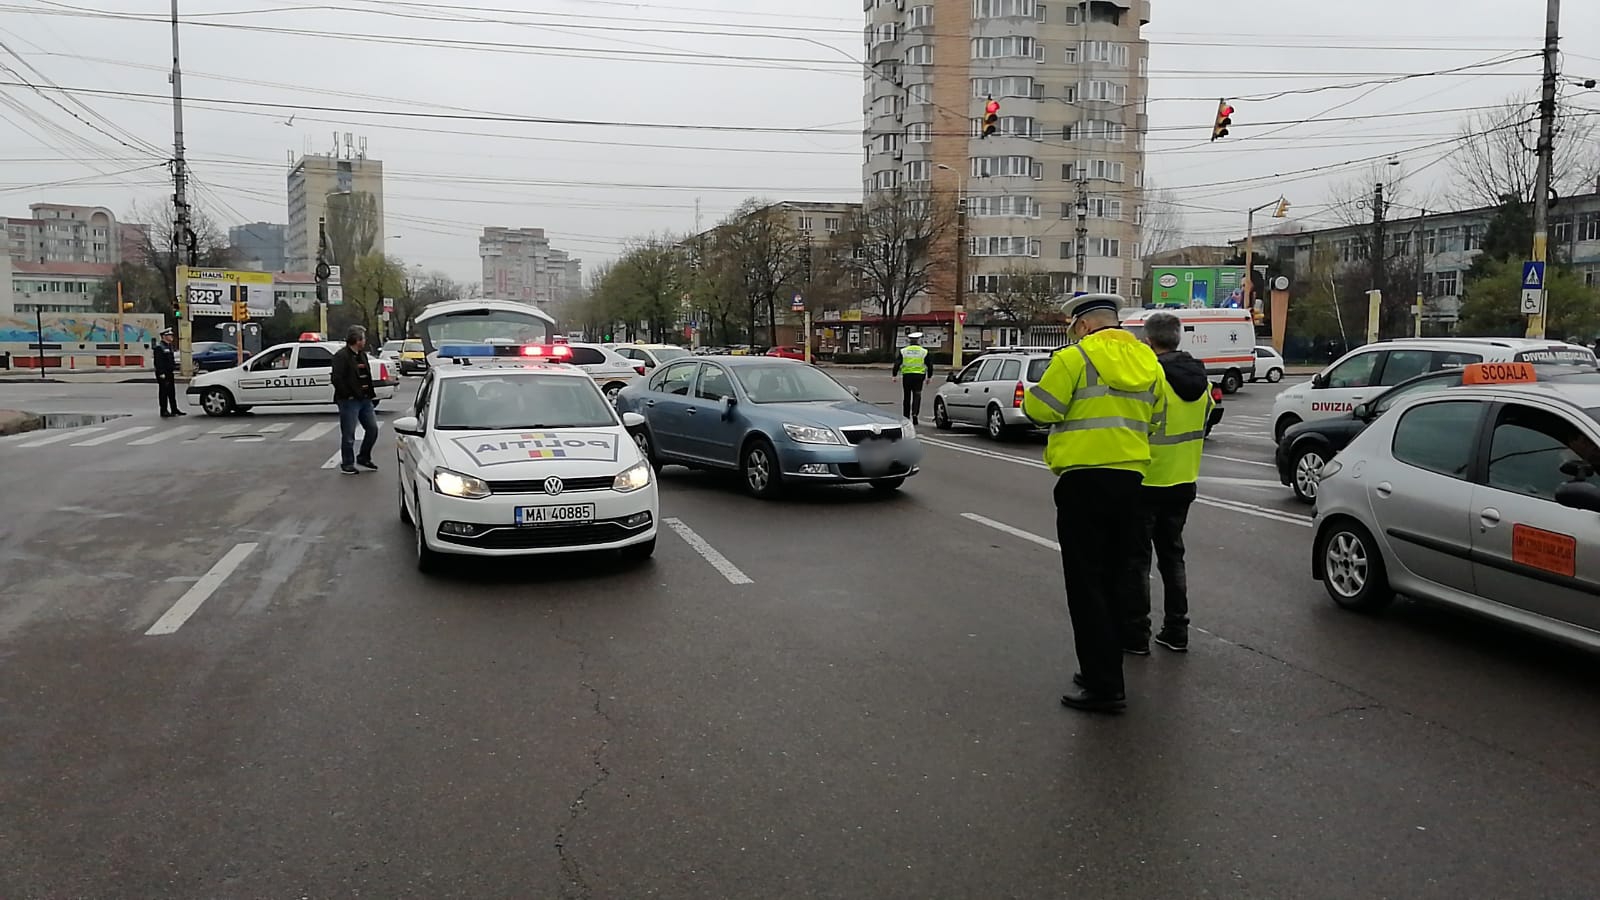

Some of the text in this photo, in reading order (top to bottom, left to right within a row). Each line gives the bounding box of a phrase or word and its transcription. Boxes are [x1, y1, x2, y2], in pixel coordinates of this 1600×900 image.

[190, 290, 215, 304] 329
[1522, 352, 1554, 362] DIVIZIA
[1481, 365, 1529, 380] SCOALA
[1312, 402, 1354, 412] DIVIZIA
[525, 506, 590, 522] MAI 40885
